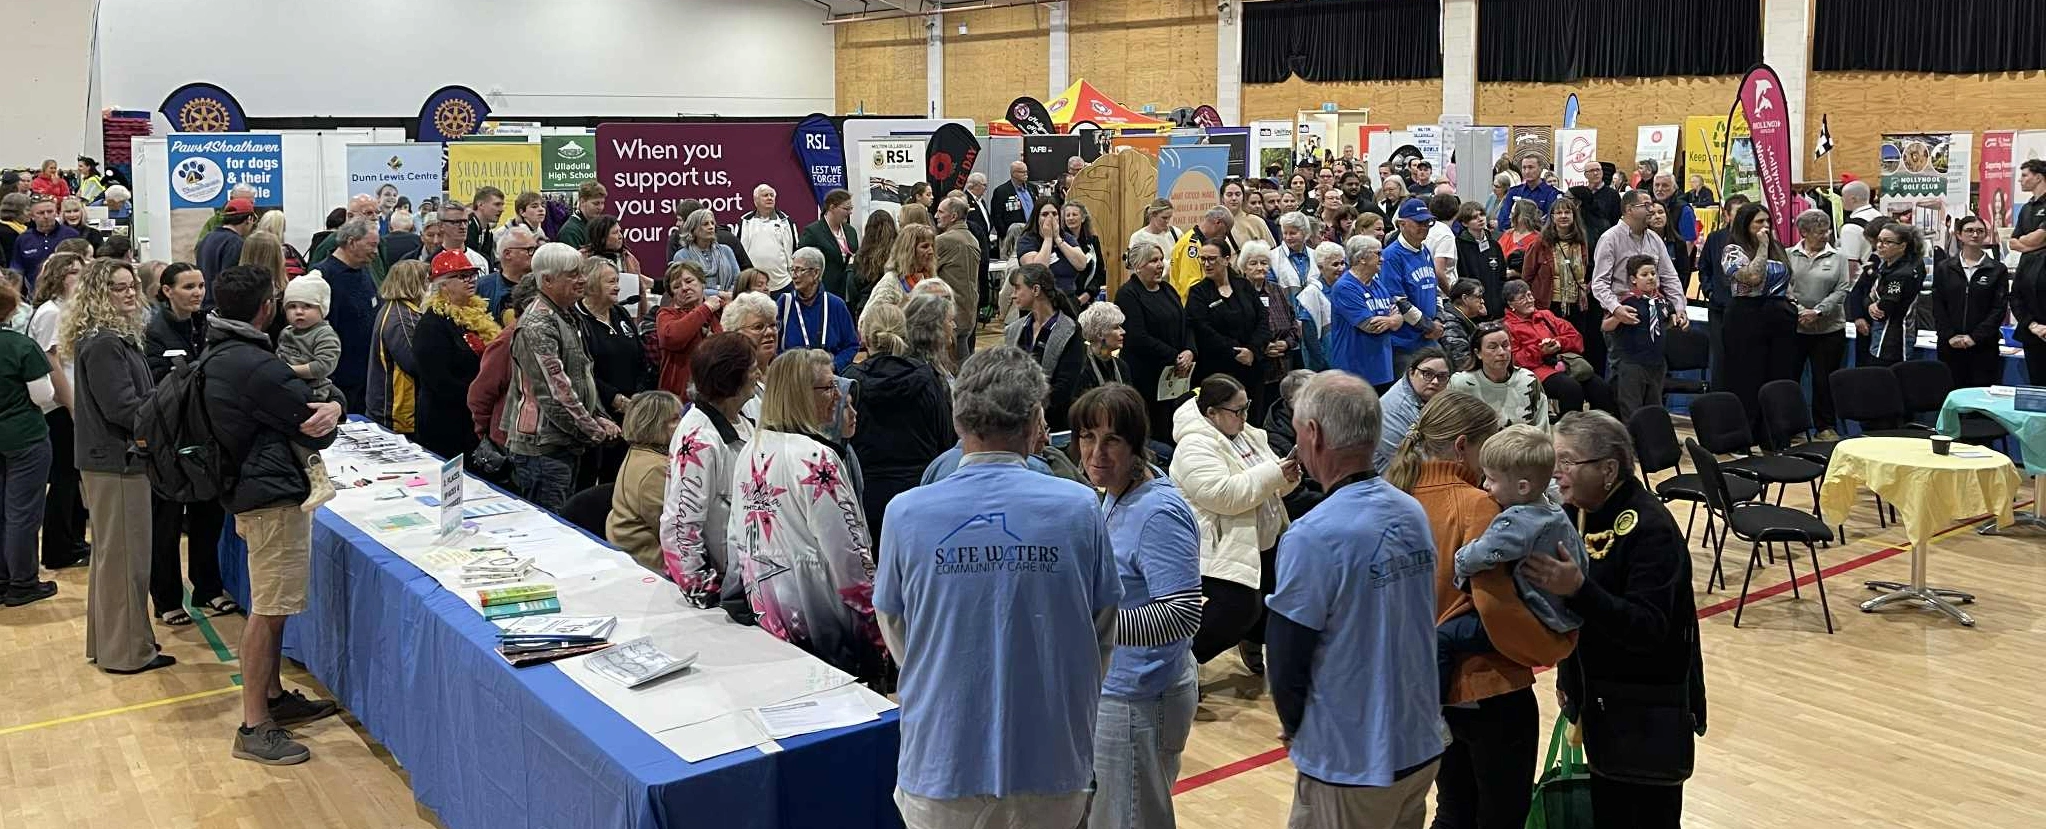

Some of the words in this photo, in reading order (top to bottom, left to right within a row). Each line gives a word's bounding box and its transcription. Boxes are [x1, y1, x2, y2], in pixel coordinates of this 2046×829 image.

[171, 140, 280, 153] Paws4Shoalhaven
[806, 133, 830, 150] RSL
[612, 138, 678, 160] When
[683, 143, 722, 166] you
[887, 150, 914, 163] RSL
[1689, 151, 1706, 165] Keep
[226, 157, 245, 169] for
[248, 157, 279, 171] dogs
[456, 161, 534, 178] SHOALHAVEN
[554, 162, 591, 171] Ulladulla
[1755, 140, 1773, 185] Women
[352, 174, 377, 182] Dunn
[379, 173, 405, 181] Lewis
[407, 172, 438, 180] Centre
[548, 171, 567, 181] High
[569, 171, 597, 179] School
[811, 165, 829, 175] LEST
[831, 165, 842, 175] WE
[227, 172, 237, 184] &
[240, 171, 272, 184] their
[614, 167, 699, 193] support
[704, 170, 732, 188] us,
[812, 174, 842, 183] FORGET
[1902, 183, 1920, 191] GOLF
[614, 199, 655, 221] you
[660, 192, 743, 214] suport
[935, 546, 979, 565] SAFE
[985, 545, 1059, 563] WATERS
[935, 561, 1004, 575] COMMUNITY
[1007, 561, 1036, 572] CARE
